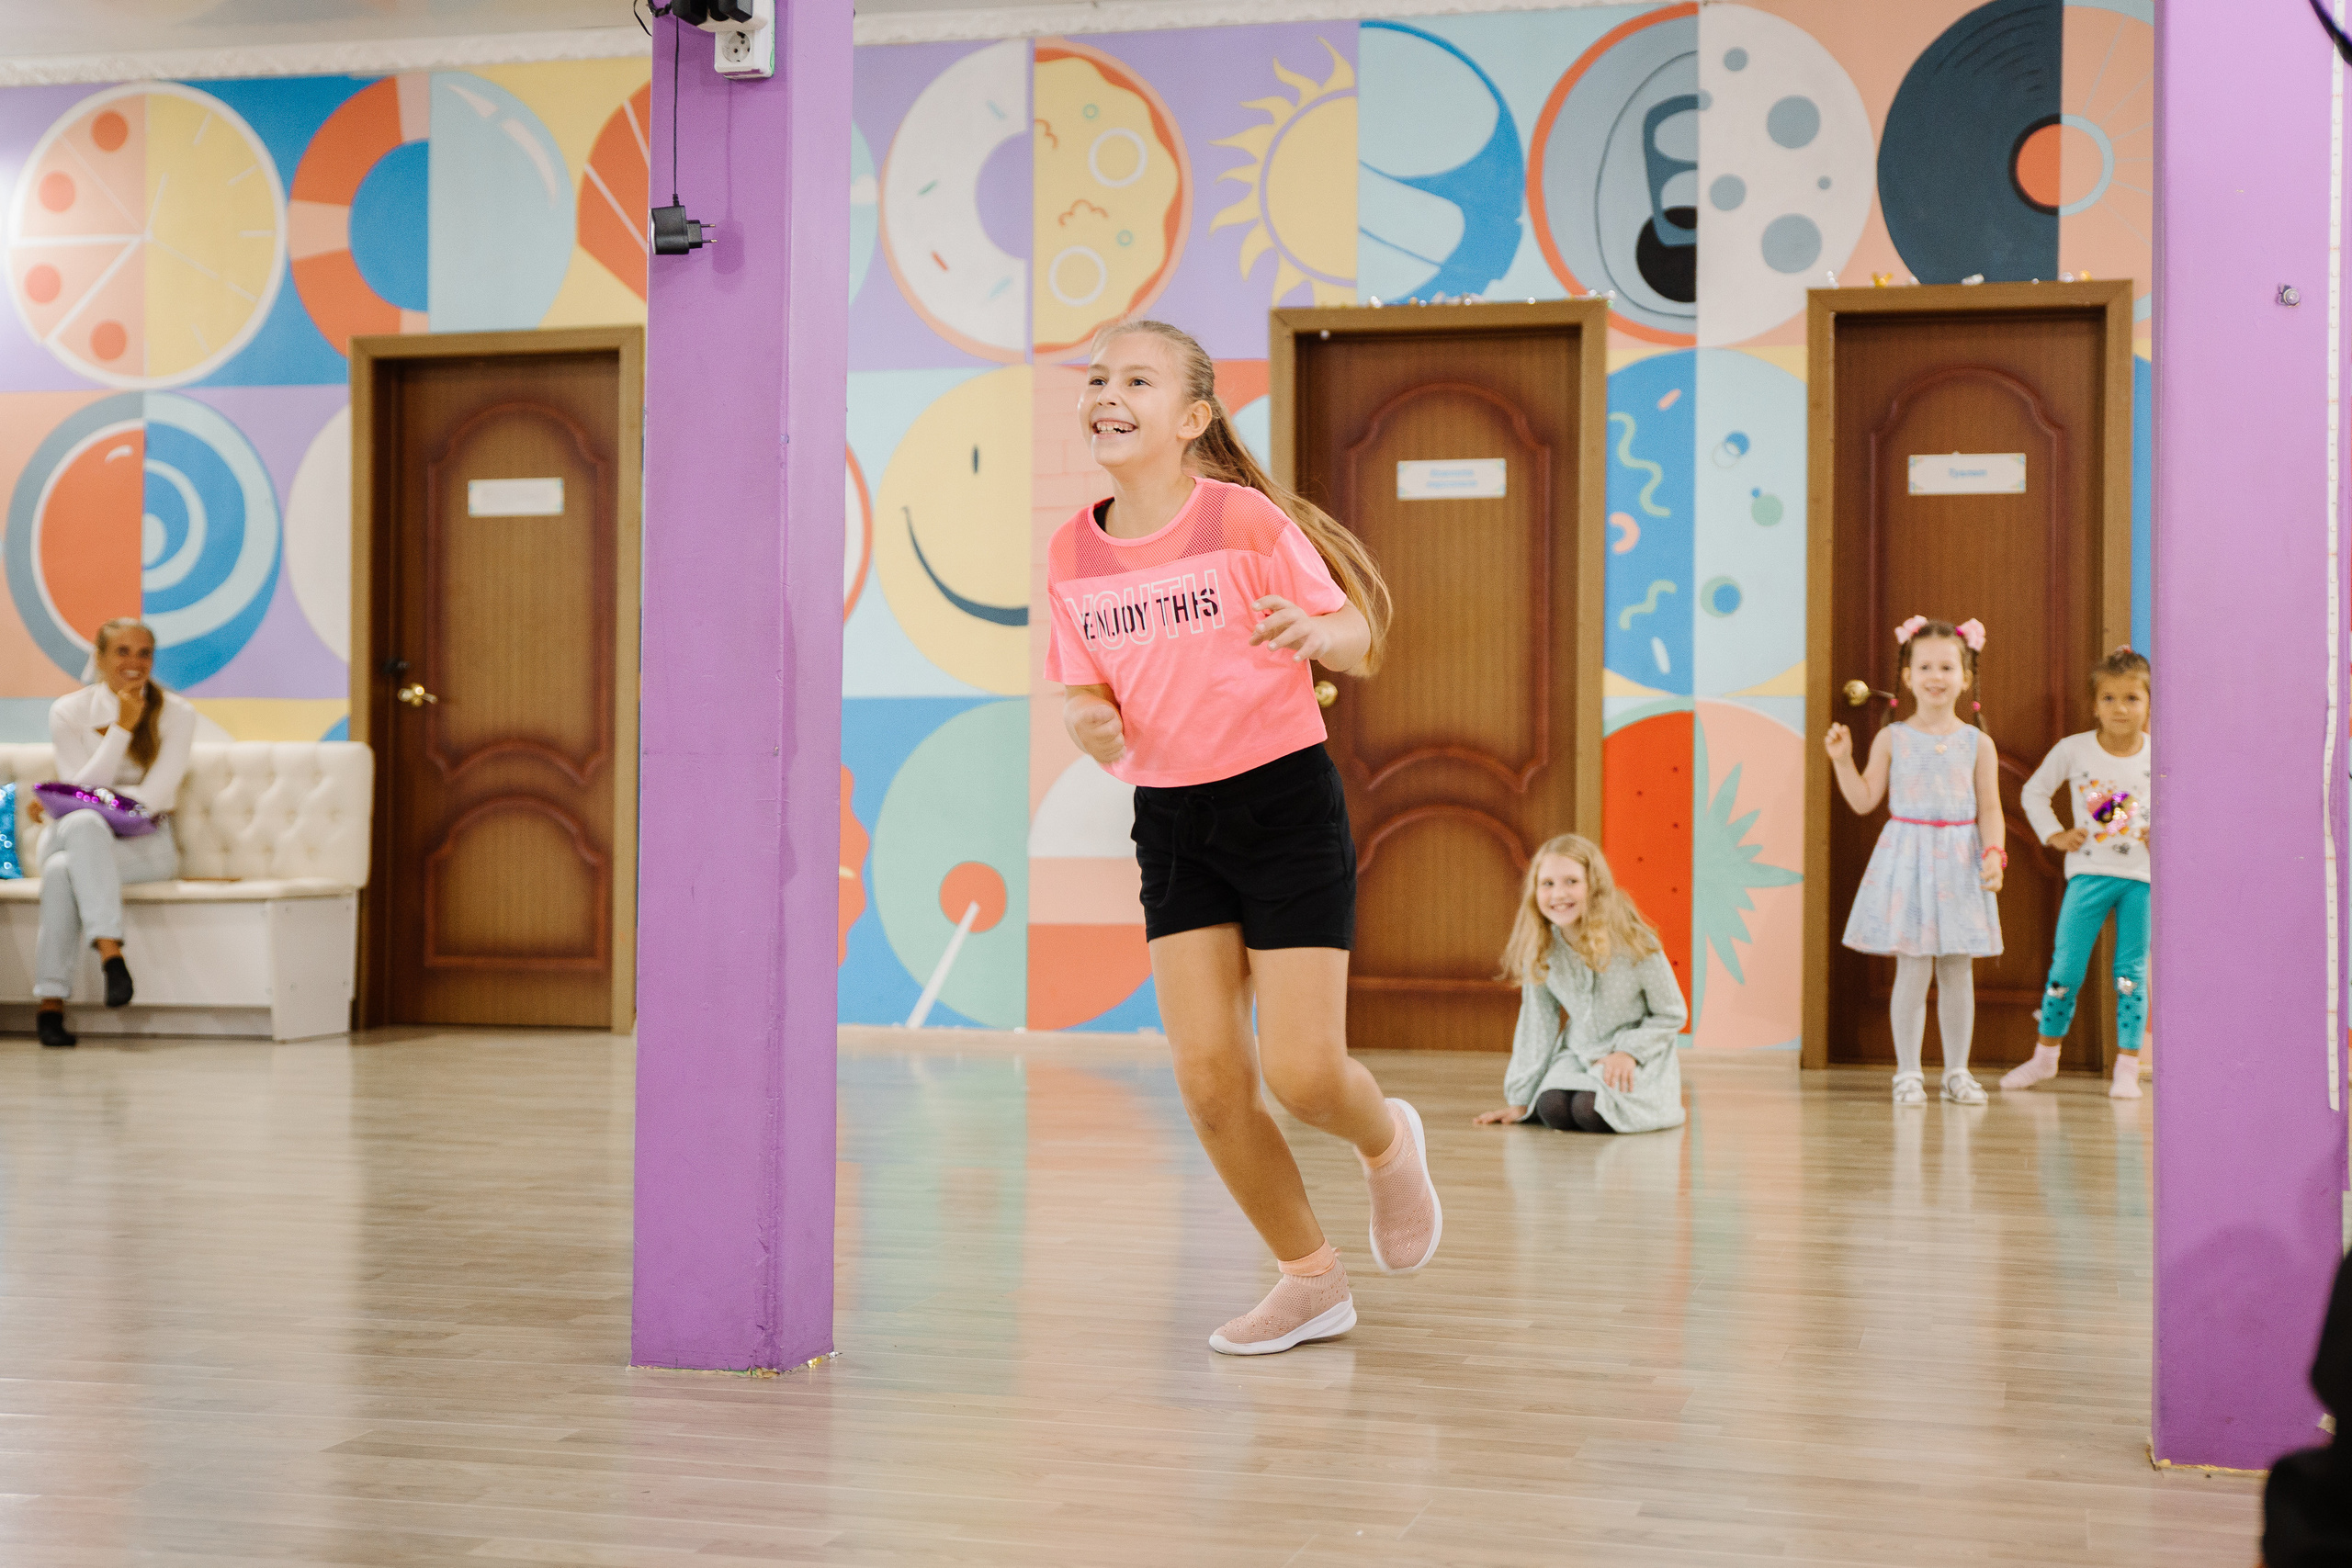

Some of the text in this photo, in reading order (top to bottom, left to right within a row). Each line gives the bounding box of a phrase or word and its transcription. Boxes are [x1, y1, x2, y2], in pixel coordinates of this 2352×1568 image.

[1066, 570, 1226, 651] YOUTH
[1081, 588, 1219, 640] ENJOY THIS
